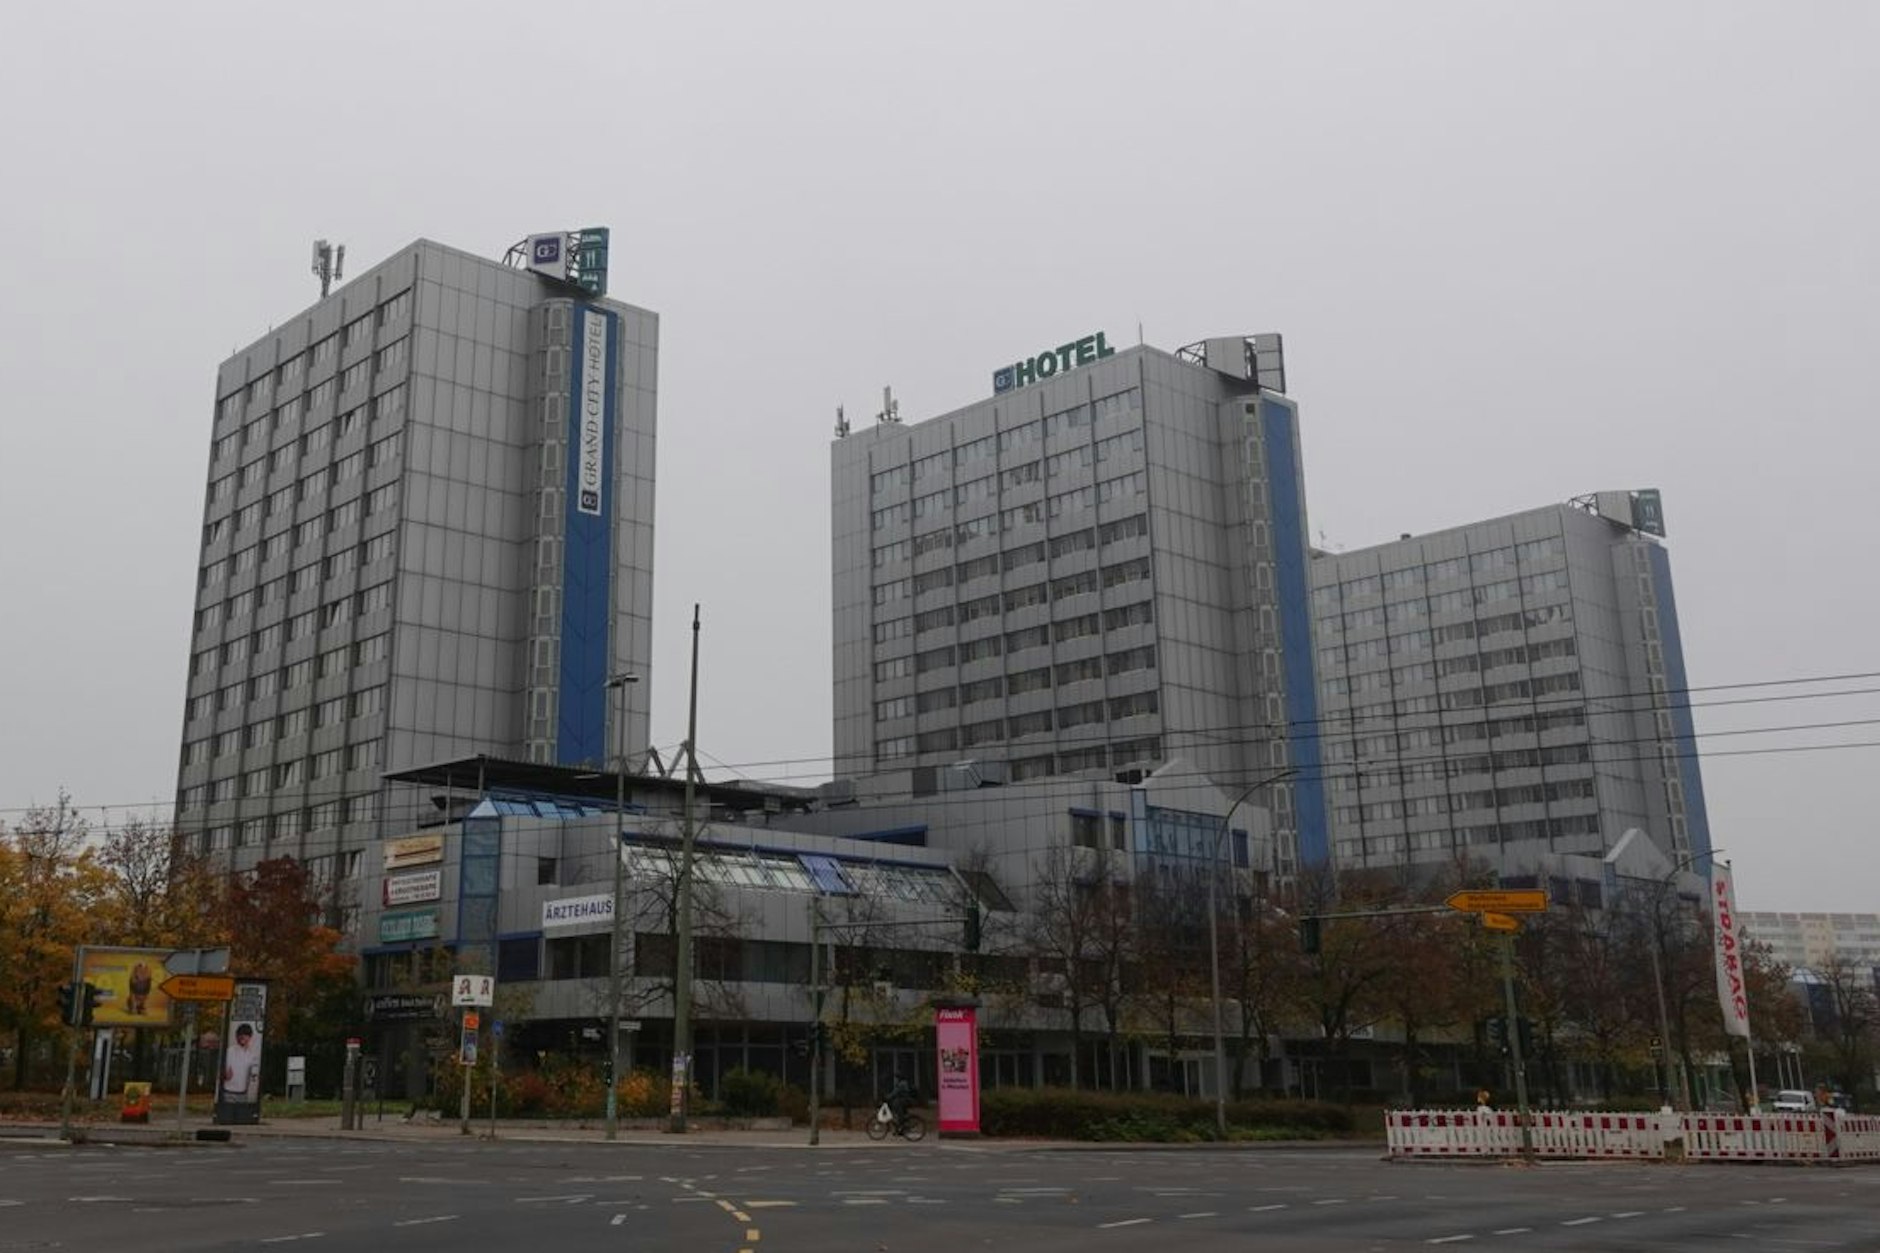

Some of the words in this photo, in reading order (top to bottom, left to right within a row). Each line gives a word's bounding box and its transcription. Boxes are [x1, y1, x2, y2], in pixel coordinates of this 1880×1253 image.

[588, 318, 602, 371] HOTEL
[1015, 330, 1116, 389] HOTEL
[586, 374, 601, 417] CITY
[584, 420, 599, 487] GRAND
[546, 899, 612, 920] ÄRZTEHAUS
